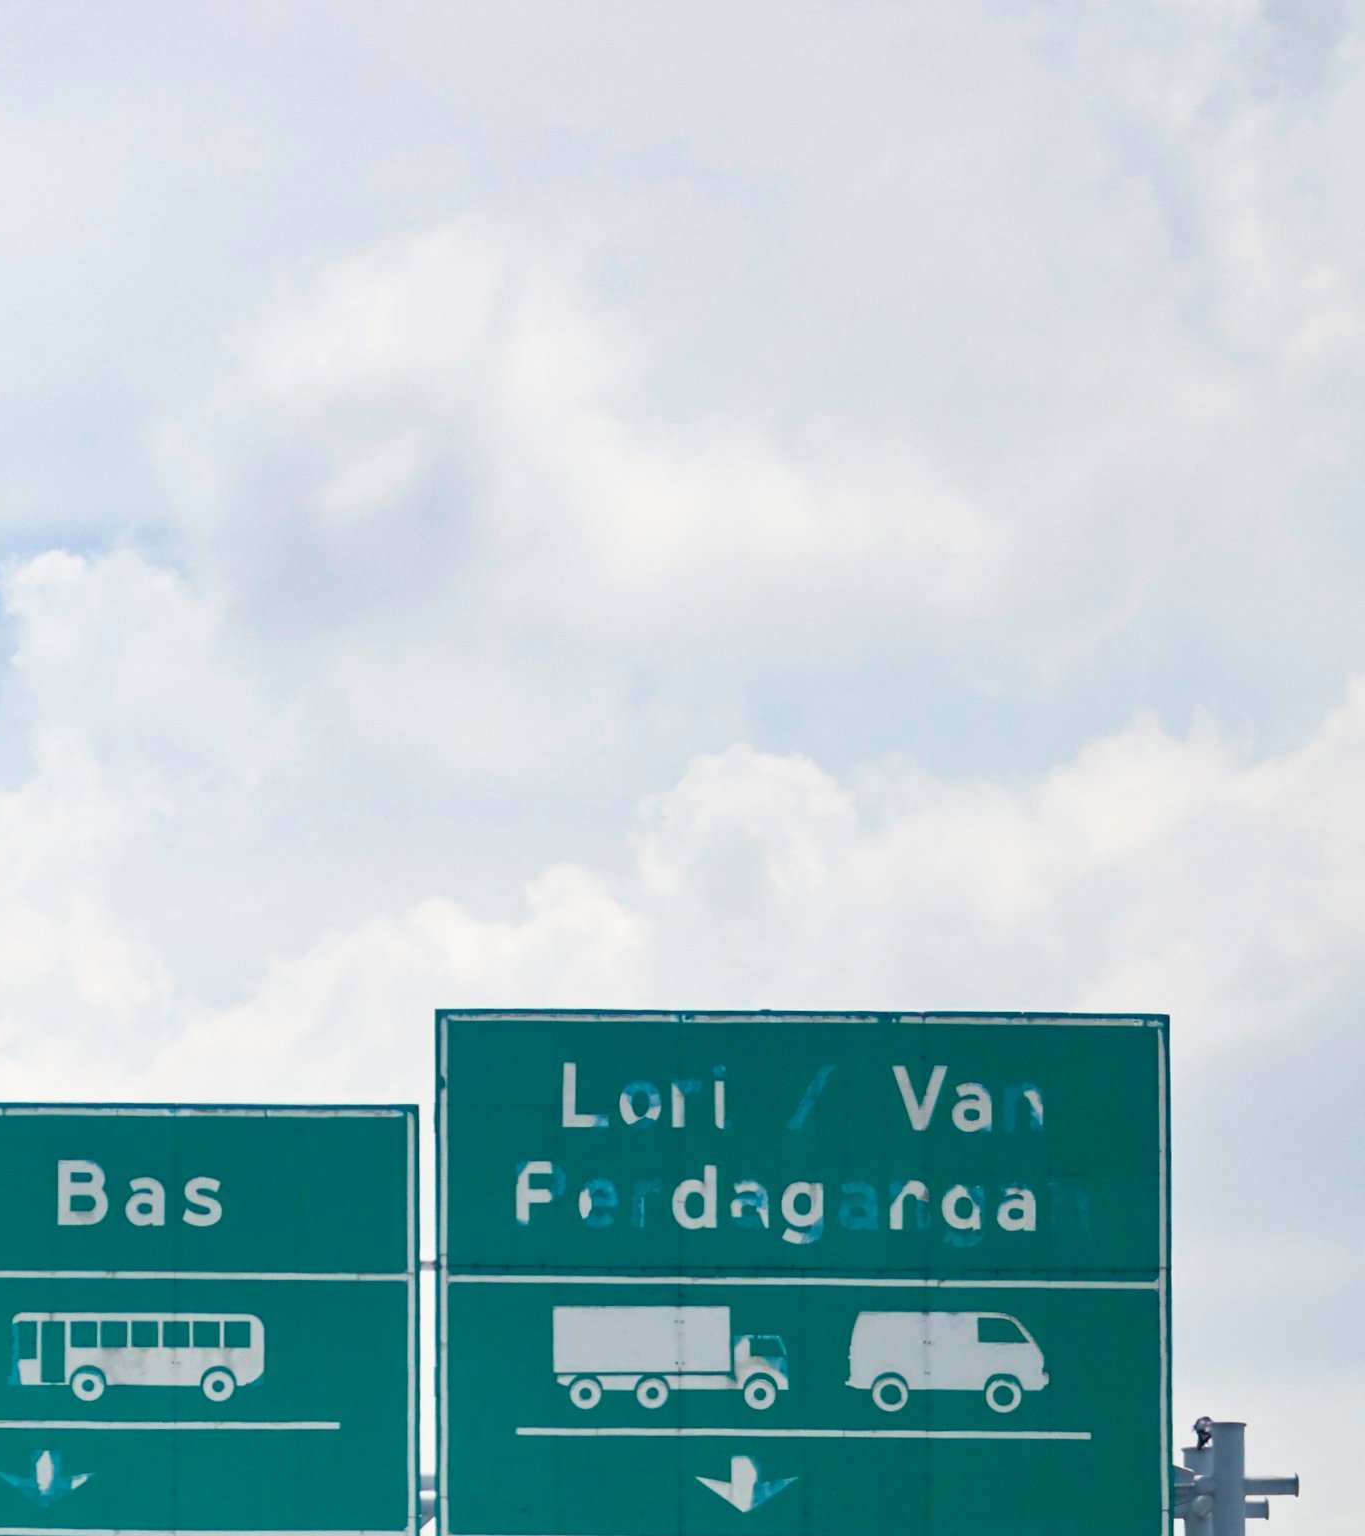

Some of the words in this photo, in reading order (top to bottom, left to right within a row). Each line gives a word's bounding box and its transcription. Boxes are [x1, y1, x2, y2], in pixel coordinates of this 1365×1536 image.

[562, 1062, 726, 1129] Lori
[893, 1065, 1044, 1132] Van
[58, 1160, 222, 1226] Bas
